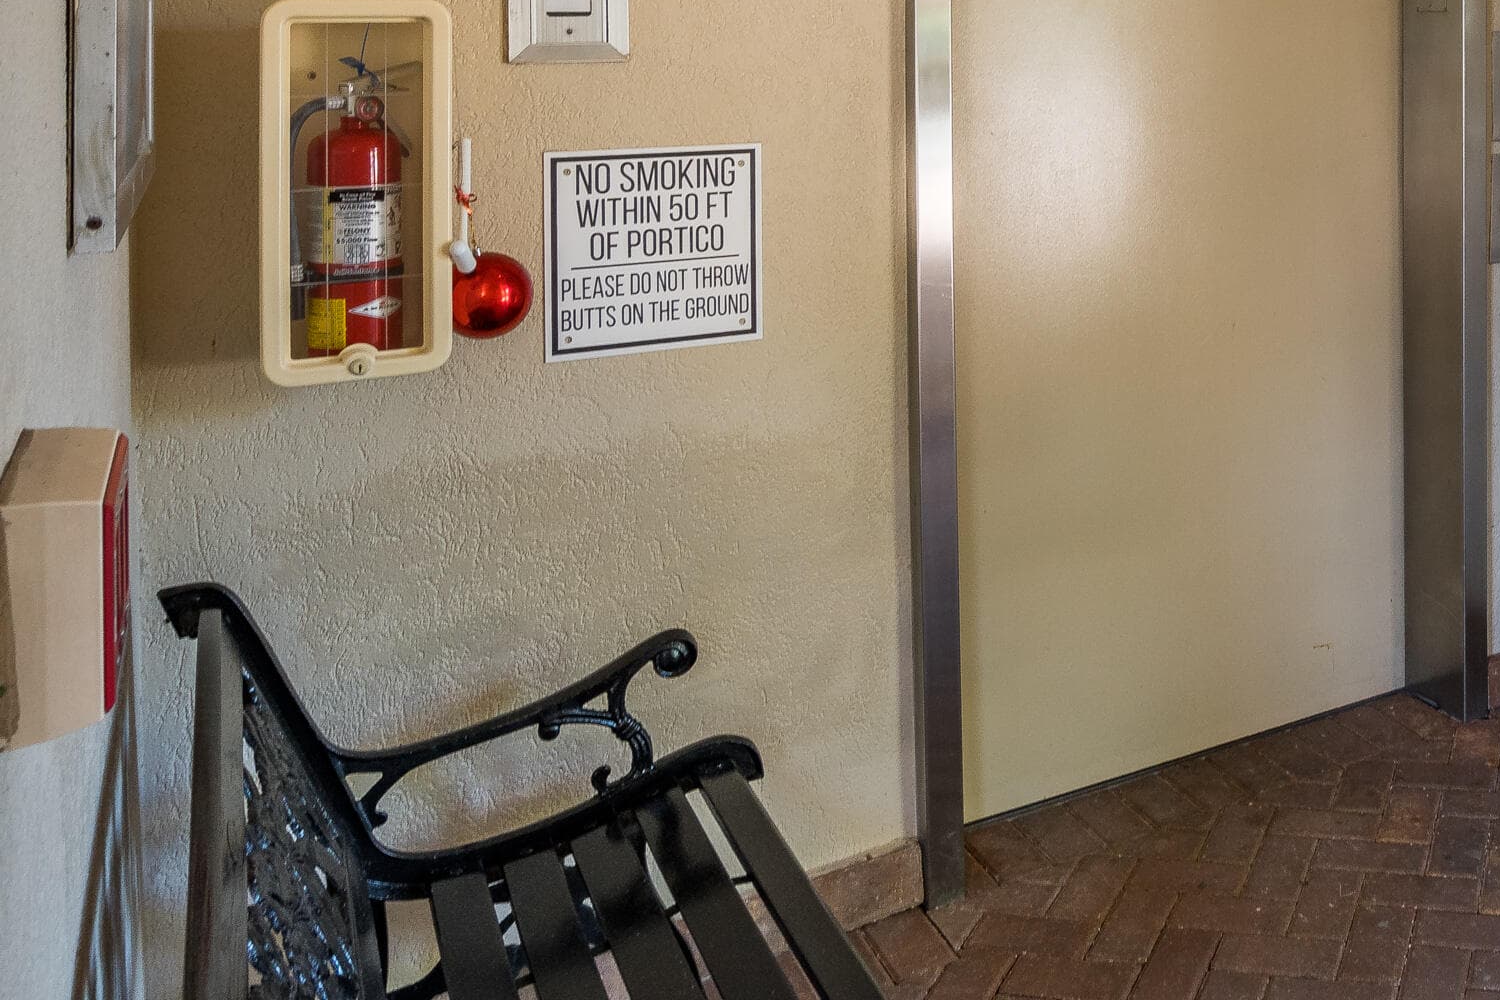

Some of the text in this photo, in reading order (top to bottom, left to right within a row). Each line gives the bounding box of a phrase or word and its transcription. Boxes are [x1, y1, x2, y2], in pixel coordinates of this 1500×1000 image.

[575, 157, 736, 196] NO SMOKING
[576, 191, 733, 228] WITHIN 50 FT
[590, 224, 724, 261] OF PORTICO
[561, 263, 749, 302] PLEASE DO NOT THROW
[561, 293, 750, 332] BUTTS ON THE GROUND
